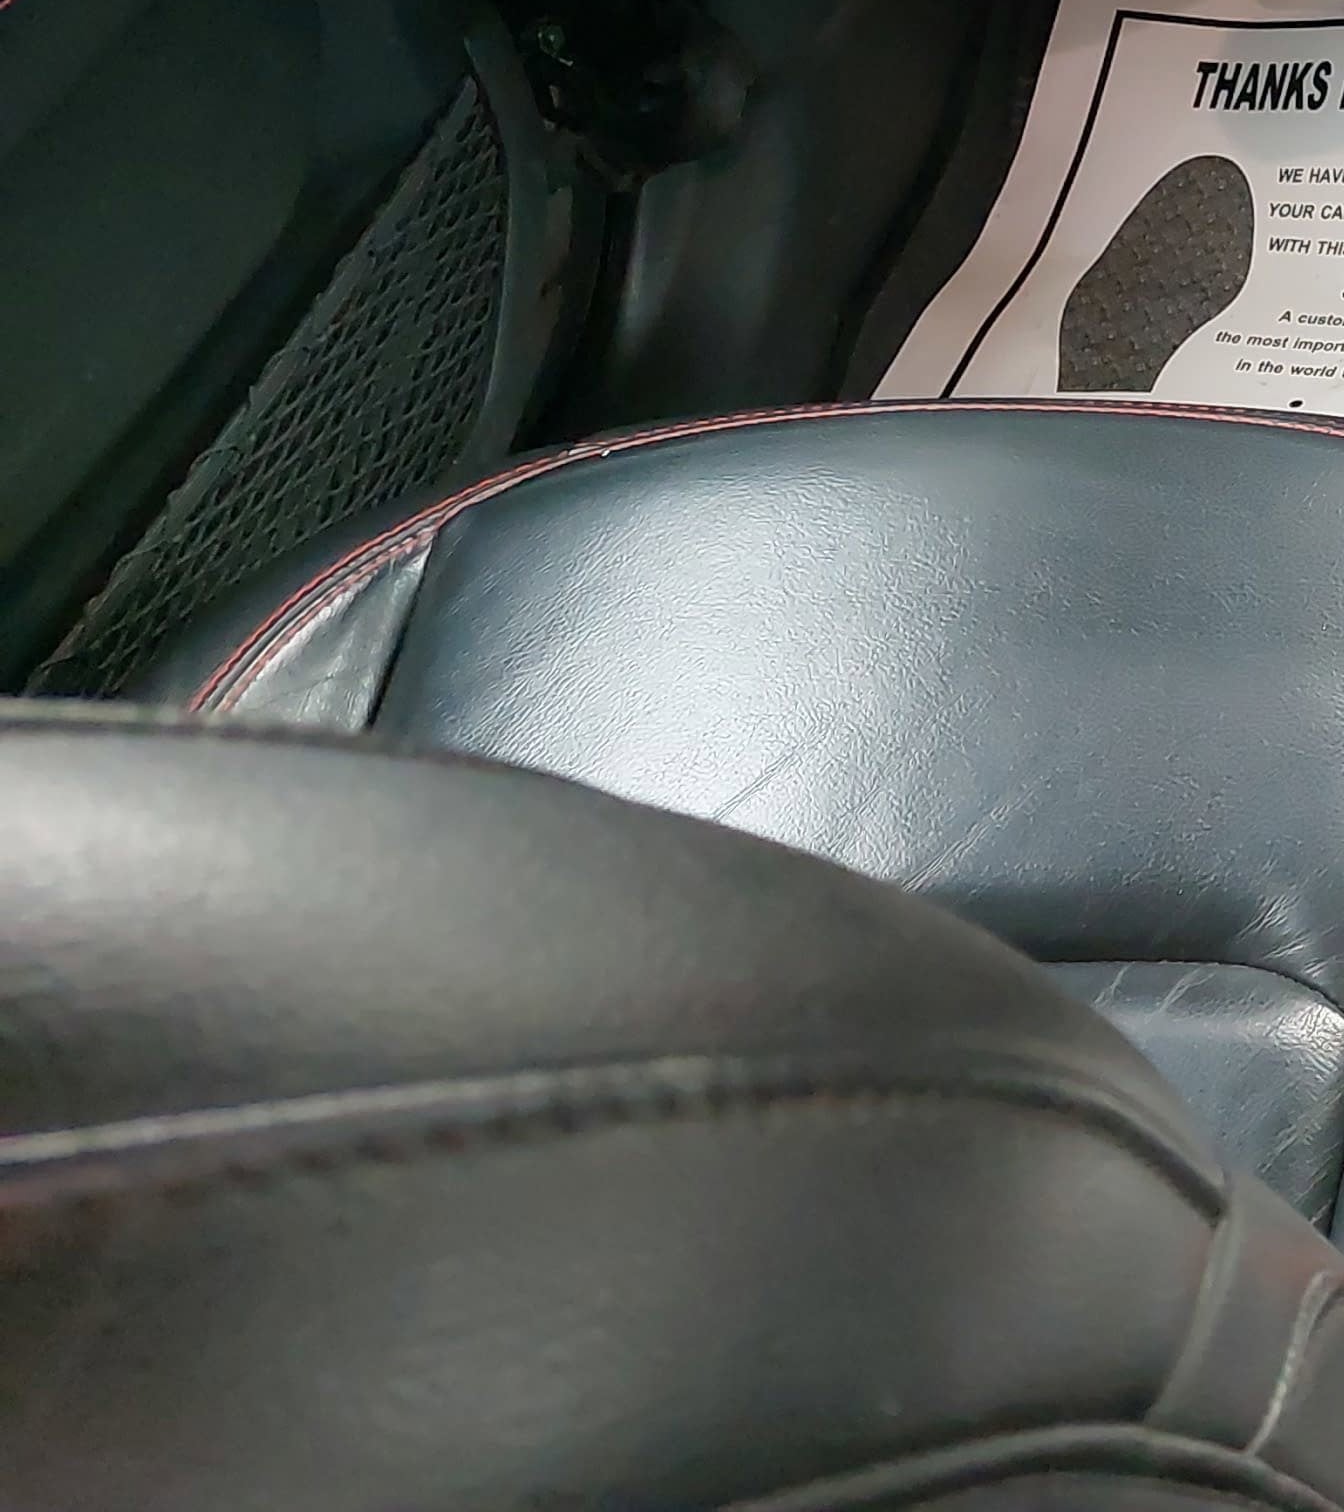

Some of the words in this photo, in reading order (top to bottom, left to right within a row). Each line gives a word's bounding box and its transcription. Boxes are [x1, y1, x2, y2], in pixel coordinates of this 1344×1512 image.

[1192, 61, 1330, 110] THANKS
[1278, 168, 1304, 183] WE
[1268, 203, 1315, 219] YOUR
[1268, 237, 1311, 253] WITH
[1278, 310, 1292, 323] A
[1215, 331, 1242, 344] the
[1246, 334, 1289, 348] most
[1235, 358, 1252, 371] in
[1257, 361, 1284, 374] the
[1290, 363, 1337, 378] world
